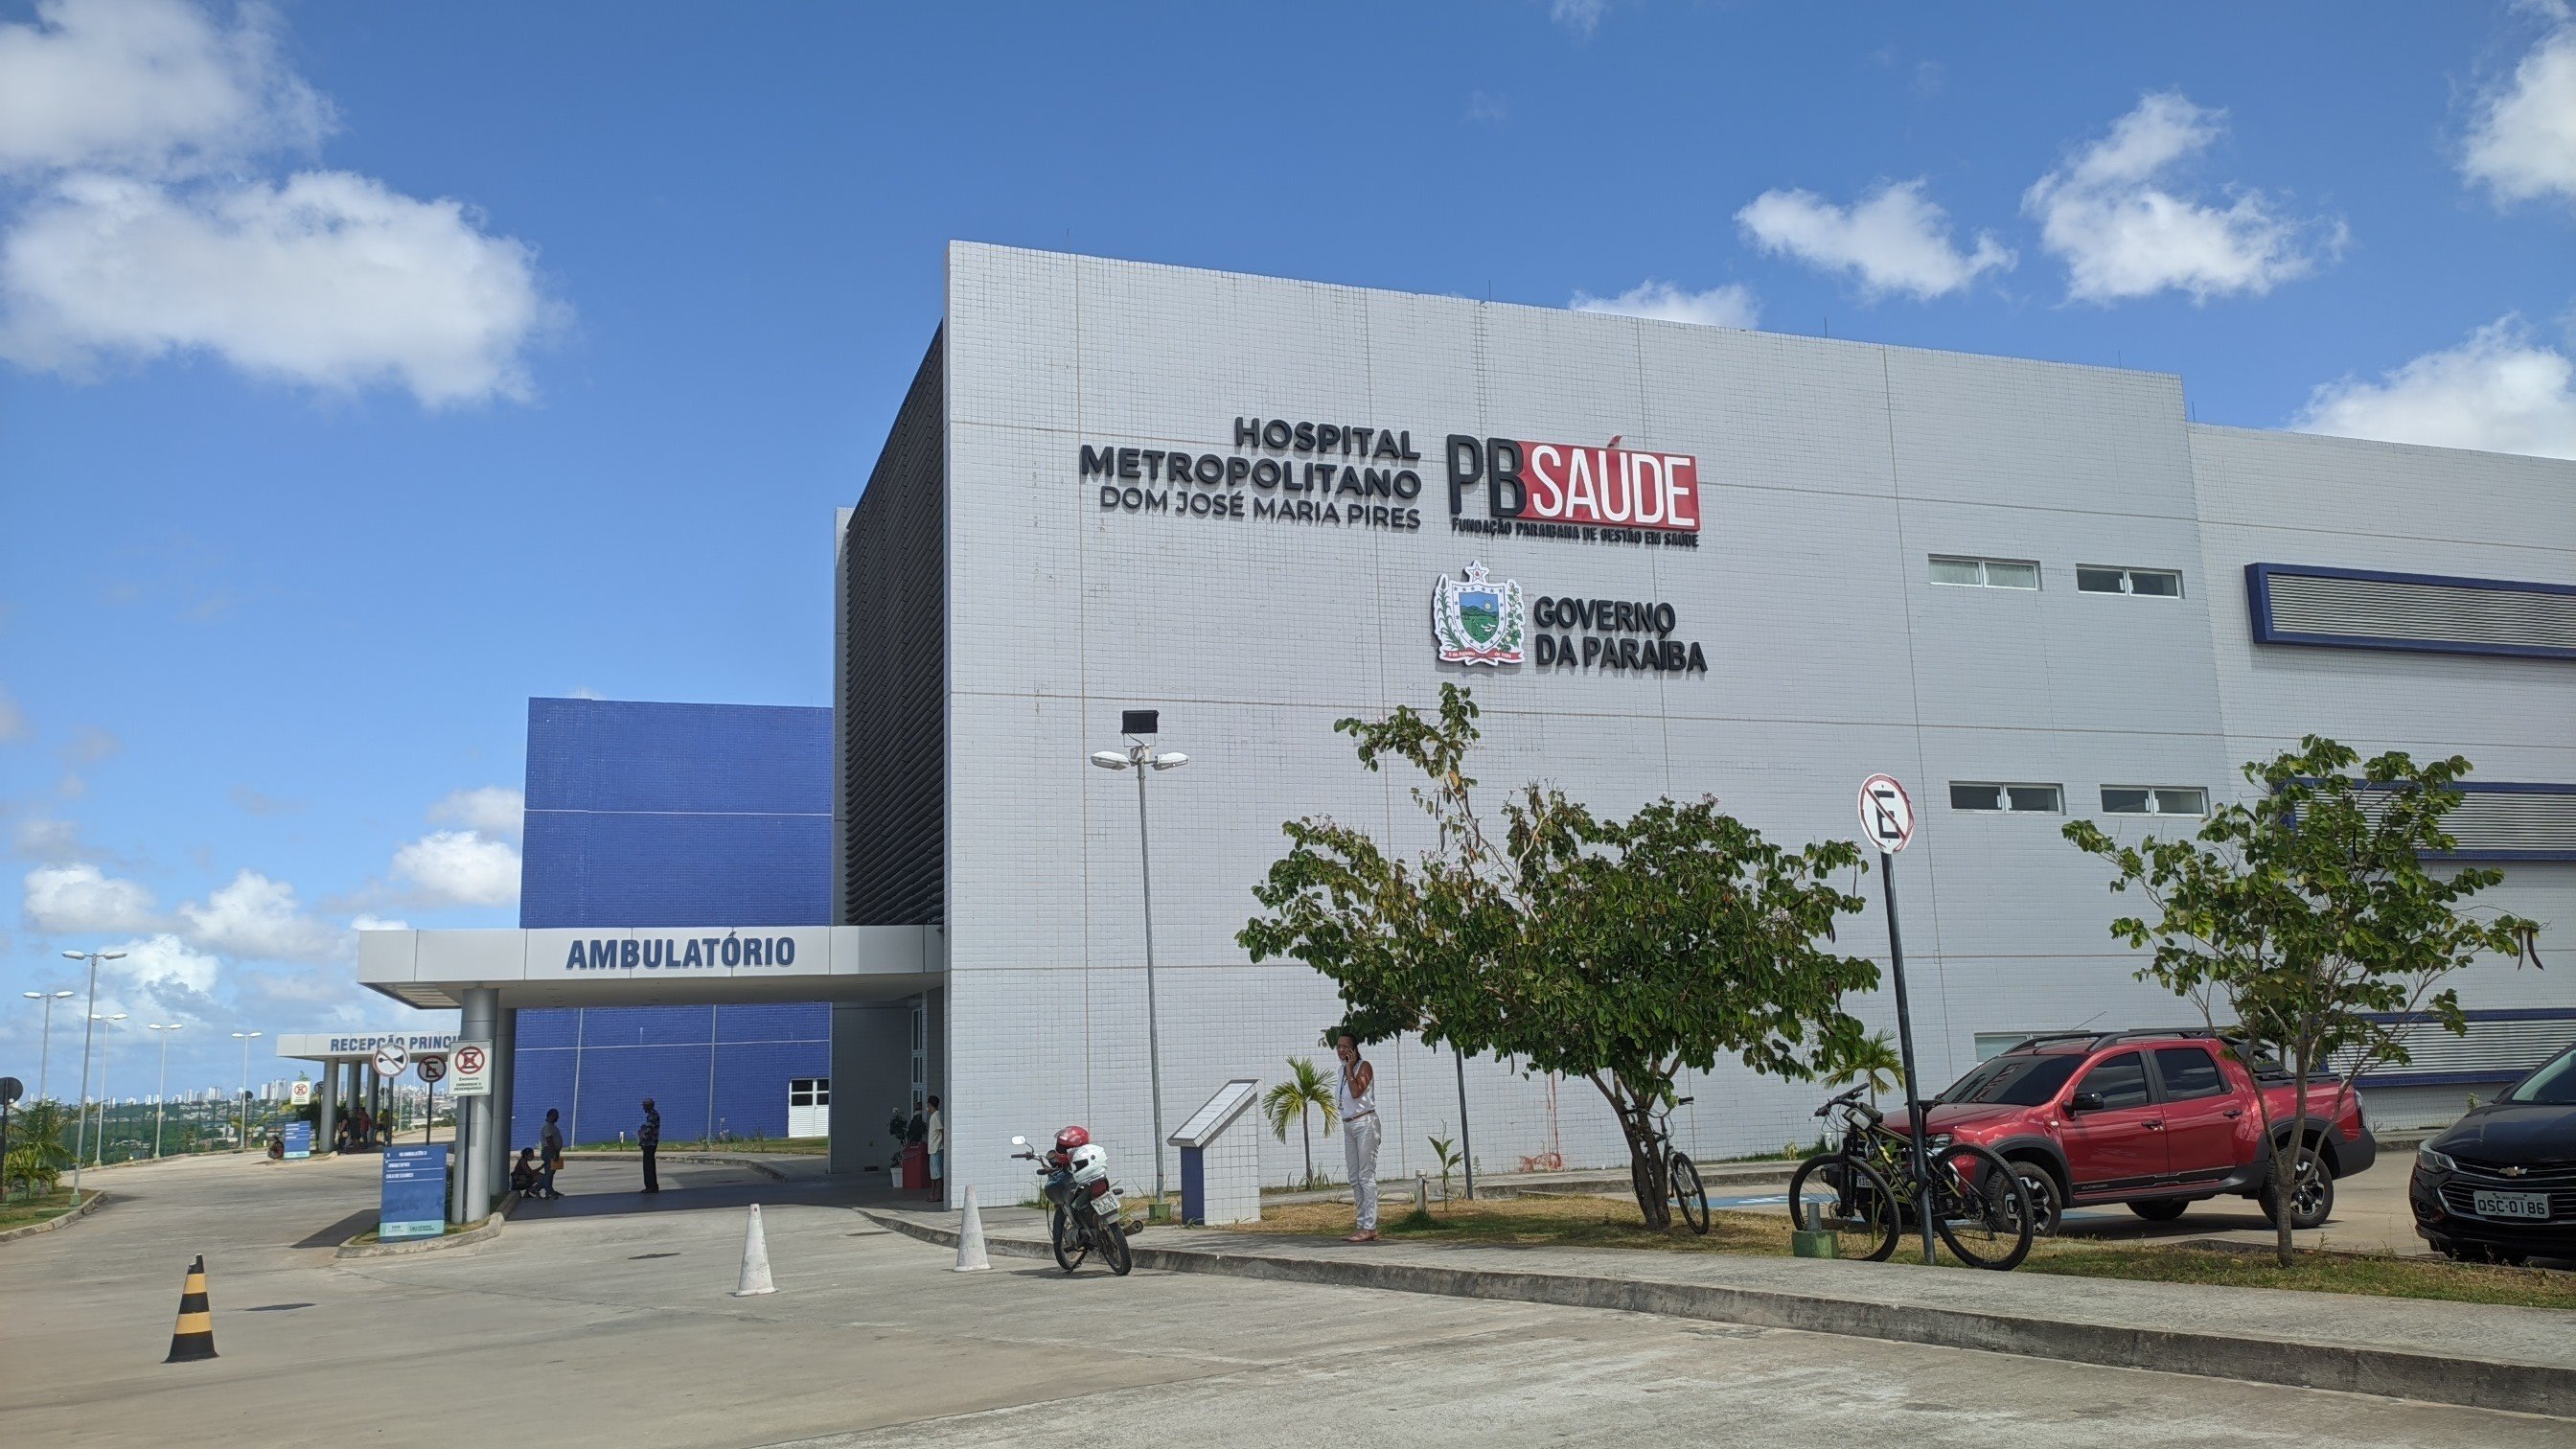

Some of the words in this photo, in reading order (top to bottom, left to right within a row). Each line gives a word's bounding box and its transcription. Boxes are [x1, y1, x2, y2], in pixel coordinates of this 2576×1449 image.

[1233, 416, 1421, 460] HOSPITAL
[1081, 444, 1421, 499] METROPOLITANO
[1100, 485, 1167, 511] DOM
[1176, 491, 1245, 517] JOSÉ
[1254, 497, 1340, 523] MARIA
[1347, 504, 1420, 529] PIRES
[1451, 518, 1512, 536] FUNDAÇÃO
[1582, 527, 1598, 540] DE
[1600, 527, 1642, 544] GESTÃO
[1644, 531, 1661, 544] EM
[1664, 531, 1699, 547] SAÚDE
[1533, 595, 1676, 634] GOVERNO
[1535, 633, 1578, 666] DA
[1583, 633, 1708, 672] PARAÍBA
[565, 931, 795, 969] AMBULATÓRIO
